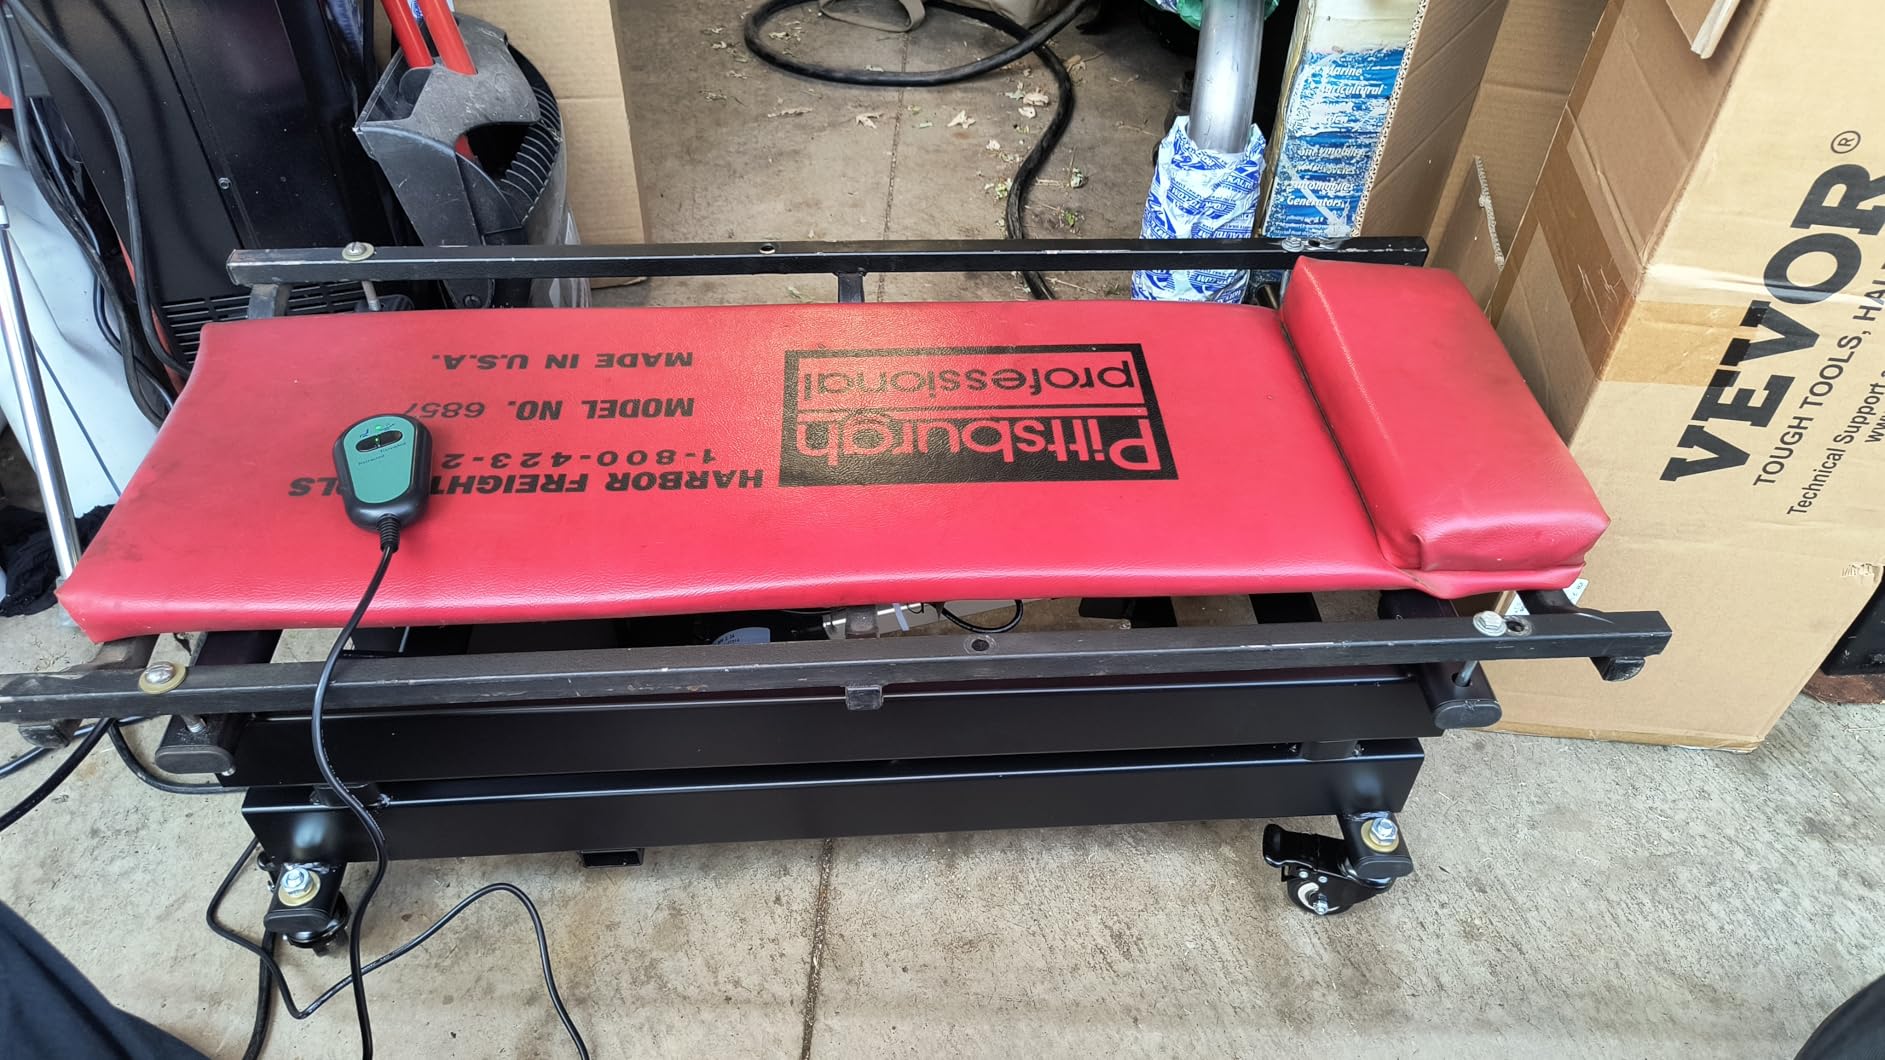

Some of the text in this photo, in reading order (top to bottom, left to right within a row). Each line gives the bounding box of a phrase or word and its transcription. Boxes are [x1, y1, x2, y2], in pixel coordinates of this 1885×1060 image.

[1659, 163, 1885, 482] VEVOR
[431, 351, 694, 370] MADE IN U.S.A.
[803, 360, 1135, 400] professional
[507, 399, 563, 421] NO.
[581, 397, 695, 419] MODEL
[1753, 416, 1814, 487] TOUGH
[1799, 331, 1872, 409] TOOLS,
[796, 415, 1162, 471] Pittsburgh
[1787, 382, 1885, 515] Technical Support
[430, 469, 764, 495] HARBOR FREIGHT
